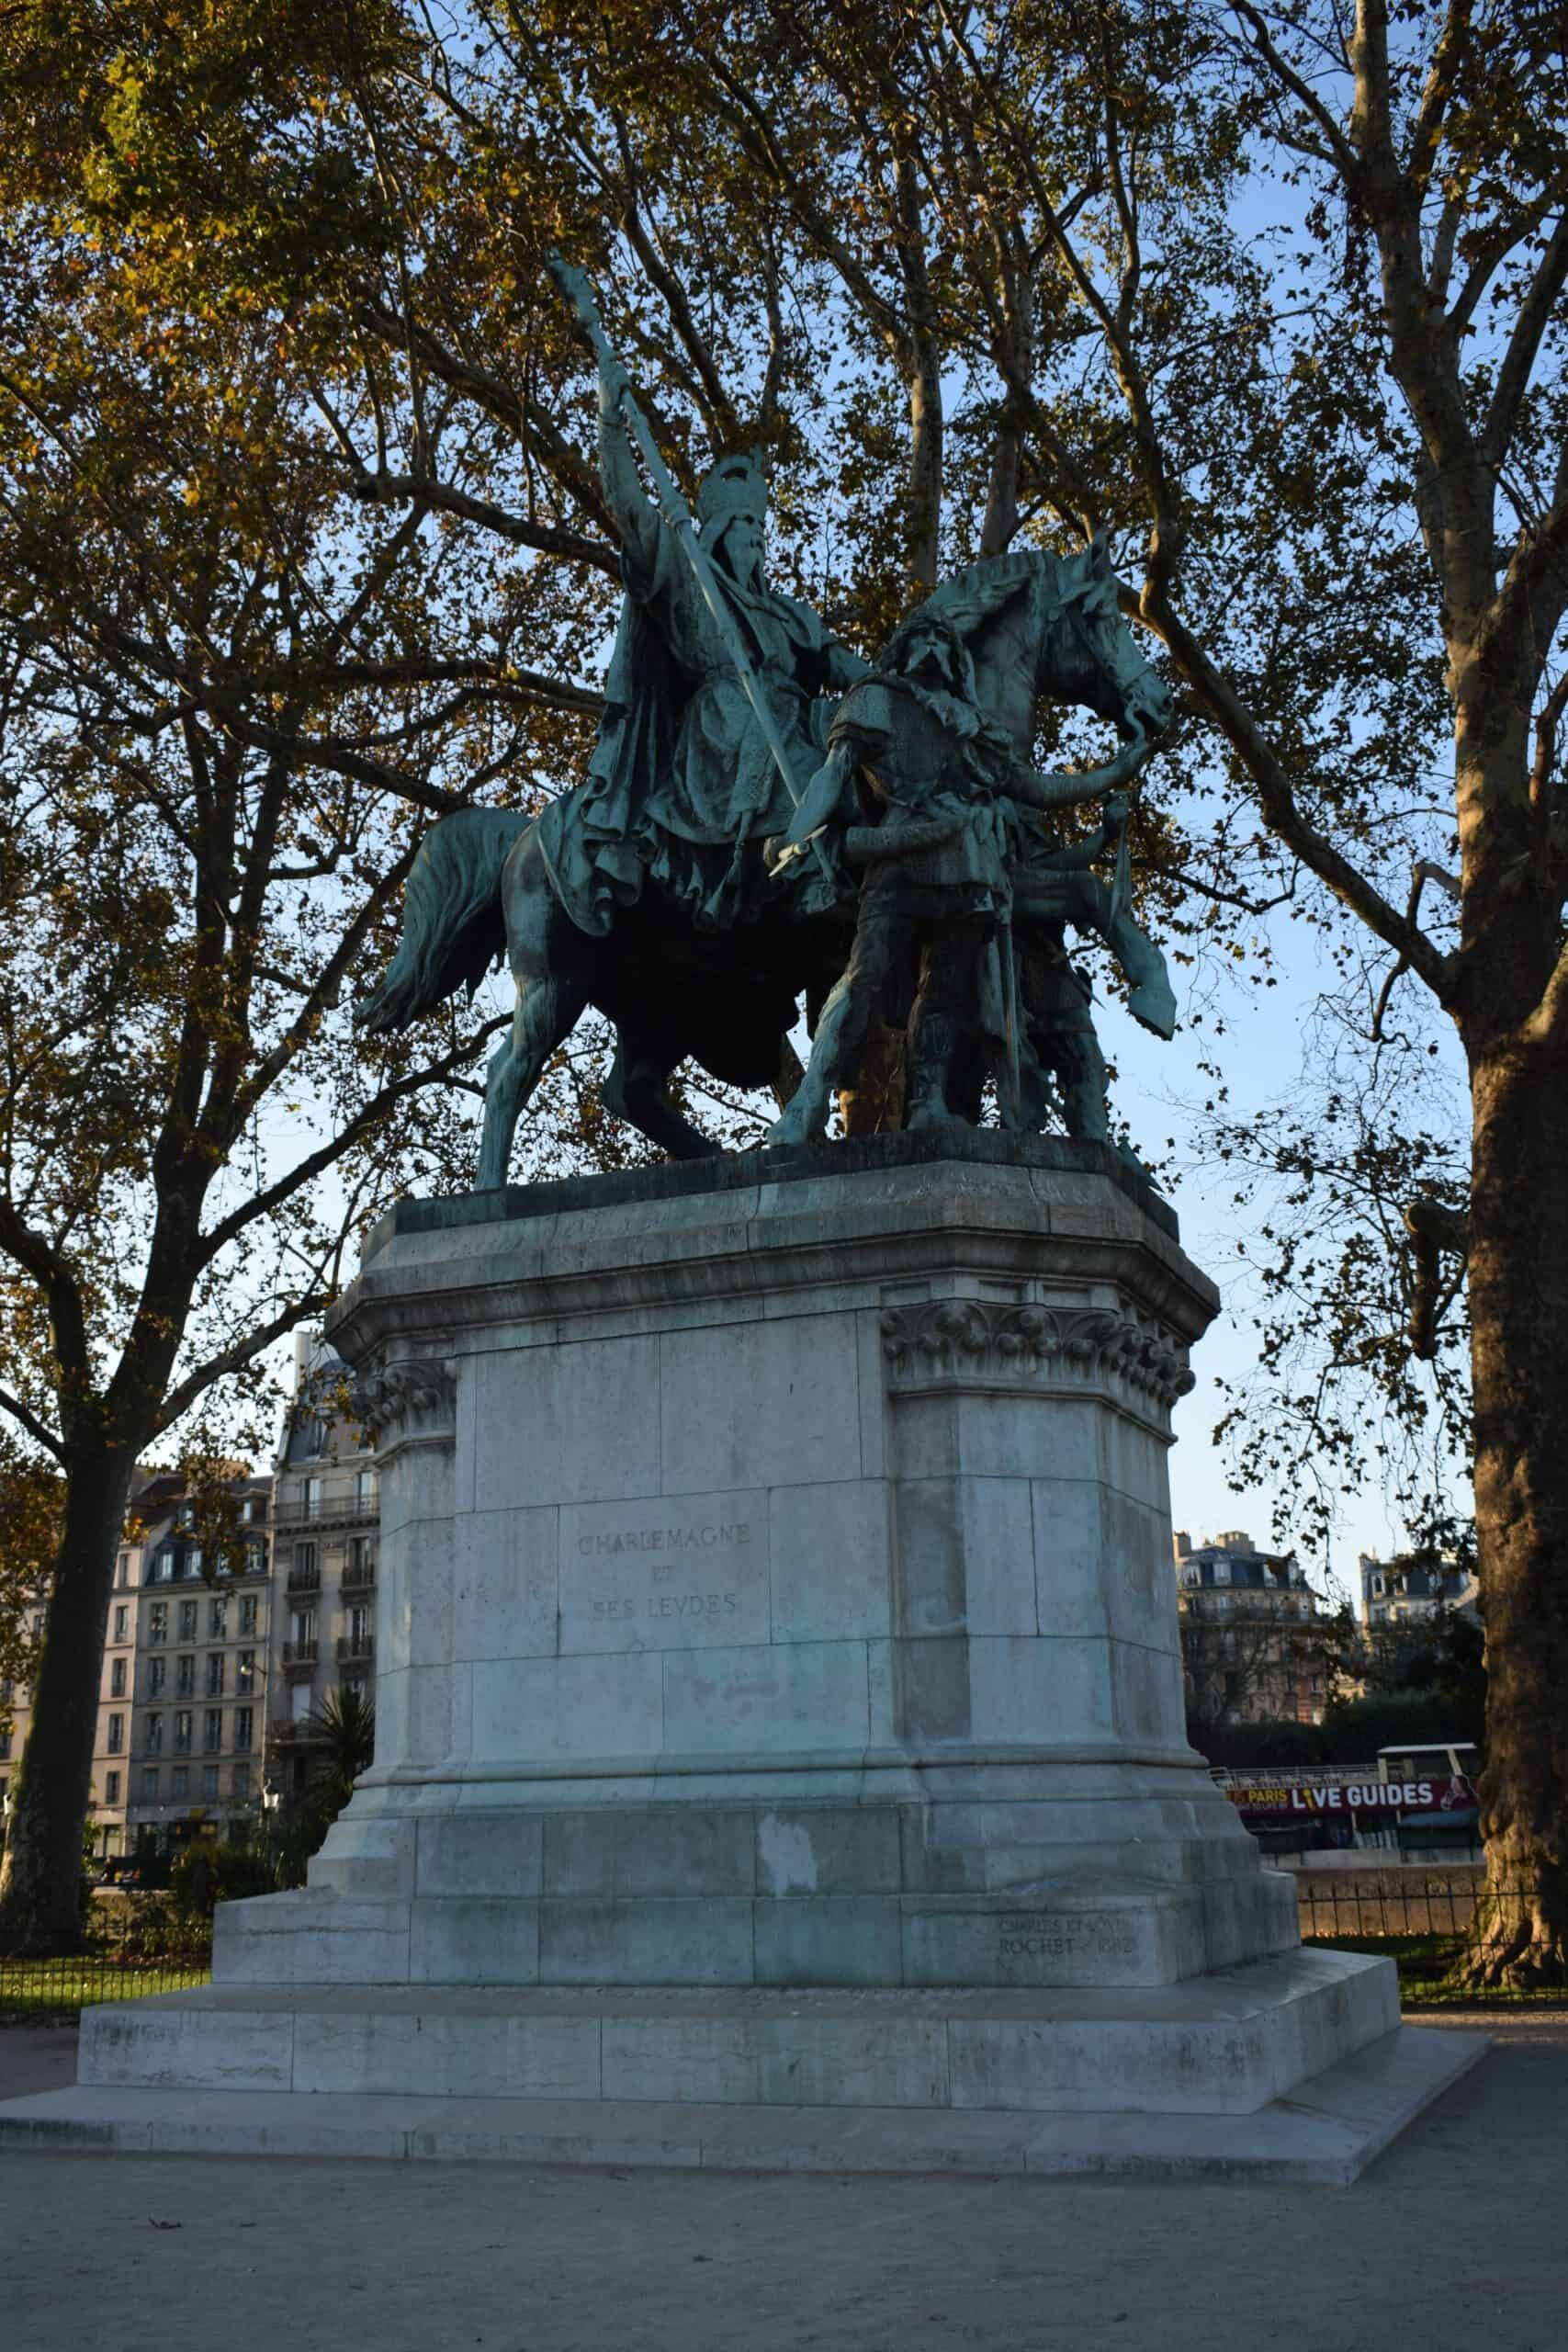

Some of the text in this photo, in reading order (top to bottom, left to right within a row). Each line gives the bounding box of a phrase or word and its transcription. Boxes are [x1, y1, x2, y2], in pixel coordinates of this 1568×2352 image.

[578, 1524, 750, 1555] CHARLEMAGNE
[651, 1565, 675, 1581] ET
[592, 1600, 634, 1621] SES
[1249, 1788, 1288, 1803] PARIS
[1292, 1787, 1342, 1809] LIVE
[1347, 1783, 1433, 1806] GUIDES
[998, 1938, 1076, 1955] ROCHET
